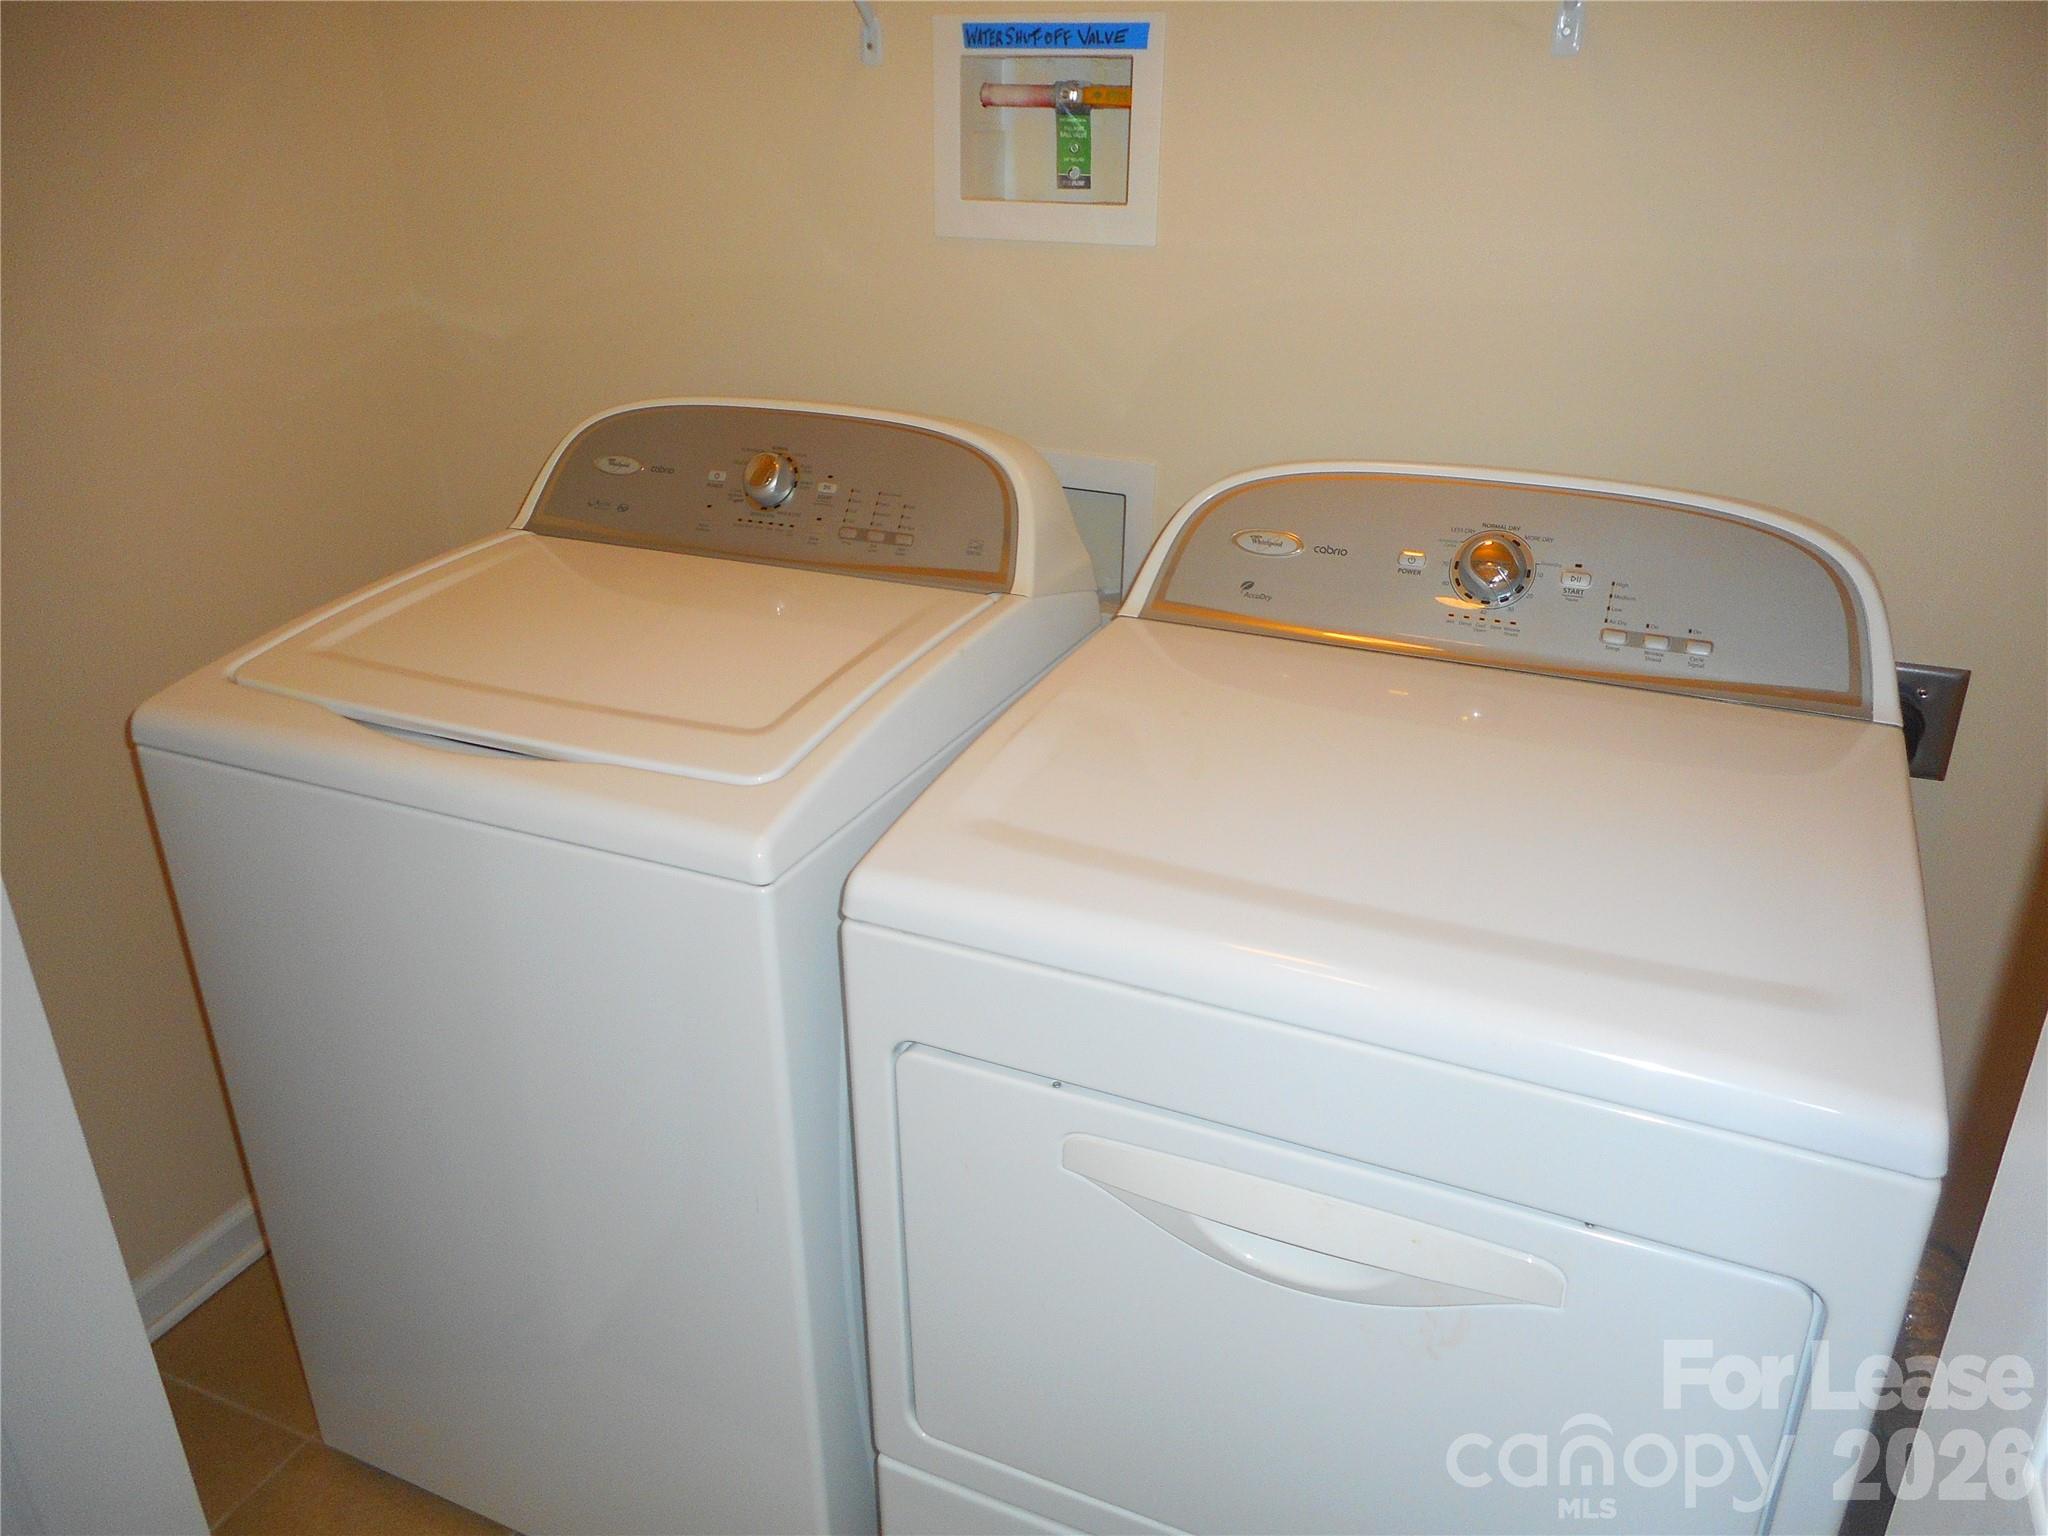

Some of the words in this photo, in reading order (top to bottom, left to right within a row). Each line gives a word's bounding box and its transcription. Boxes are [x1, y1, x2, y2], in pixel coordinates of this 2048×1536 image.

[966, 25, 1004, 47] WATER
[1045, 28, 1073, 46] OFF
[1078, 24, 1129, 46] VALVE
[1482, 522, 1507, 531] NORMAL
[1508, 524, 1522, 532] DRY
[1542, 536, 1555, 544] DRY
[1313, 544, 1349, 557] cabrio
[1397, 568, 1422, 577] POWER
[1562, 587, 1585, 596] START
[1243, 592, 1273, 602] AccuDry
